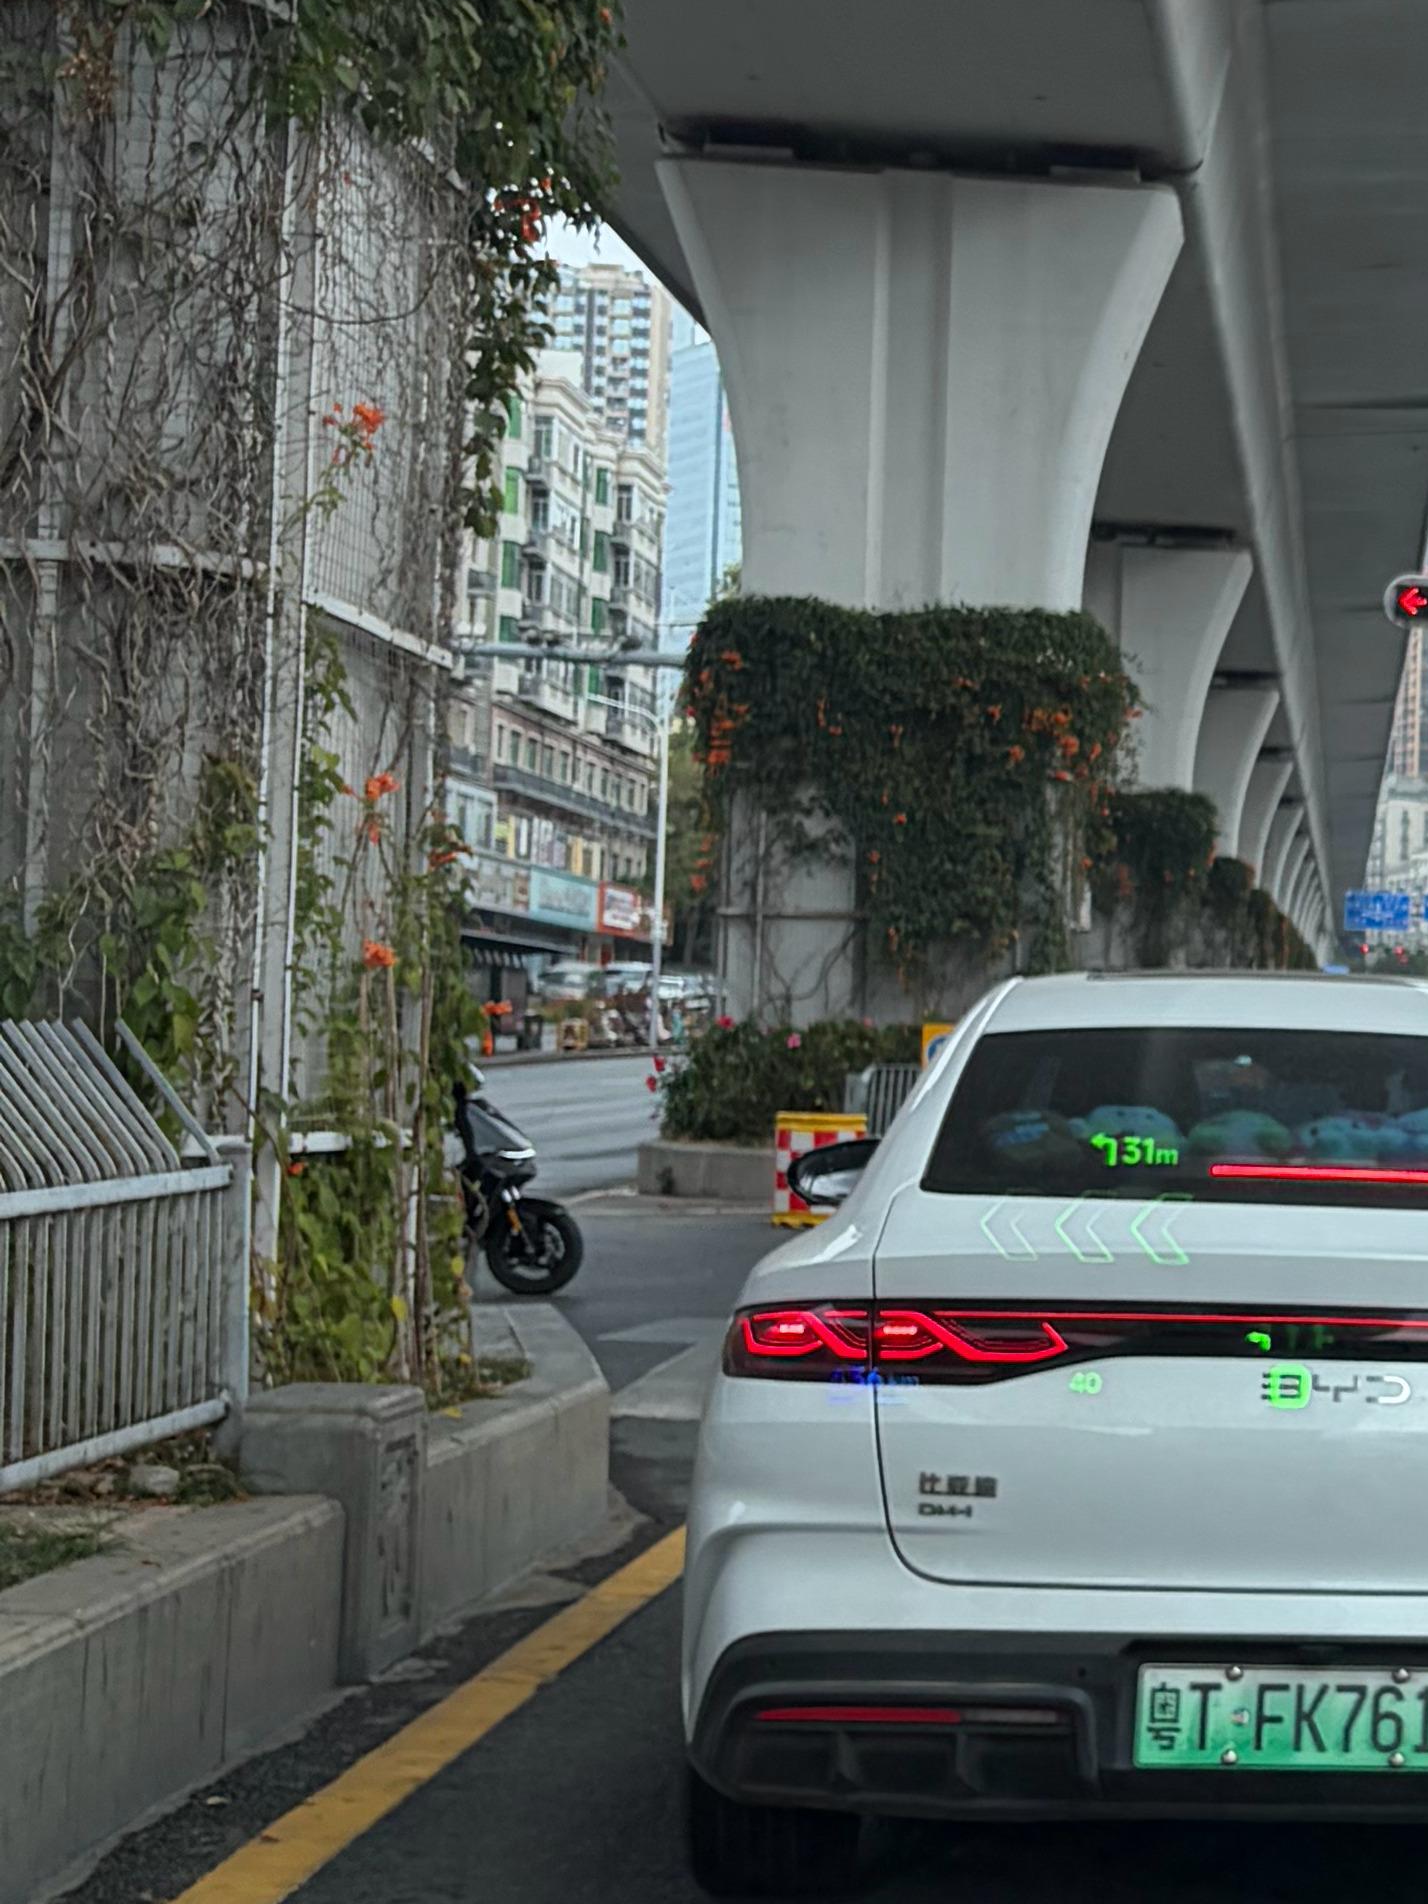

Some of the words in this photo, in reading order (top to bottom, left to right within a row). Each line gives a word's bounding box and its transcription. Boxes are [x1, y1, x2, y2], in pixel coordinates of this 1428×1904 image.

[1121, 1135, 1179, 1165] 31m
[918, 1472, 997, 1498] 比亚迪
